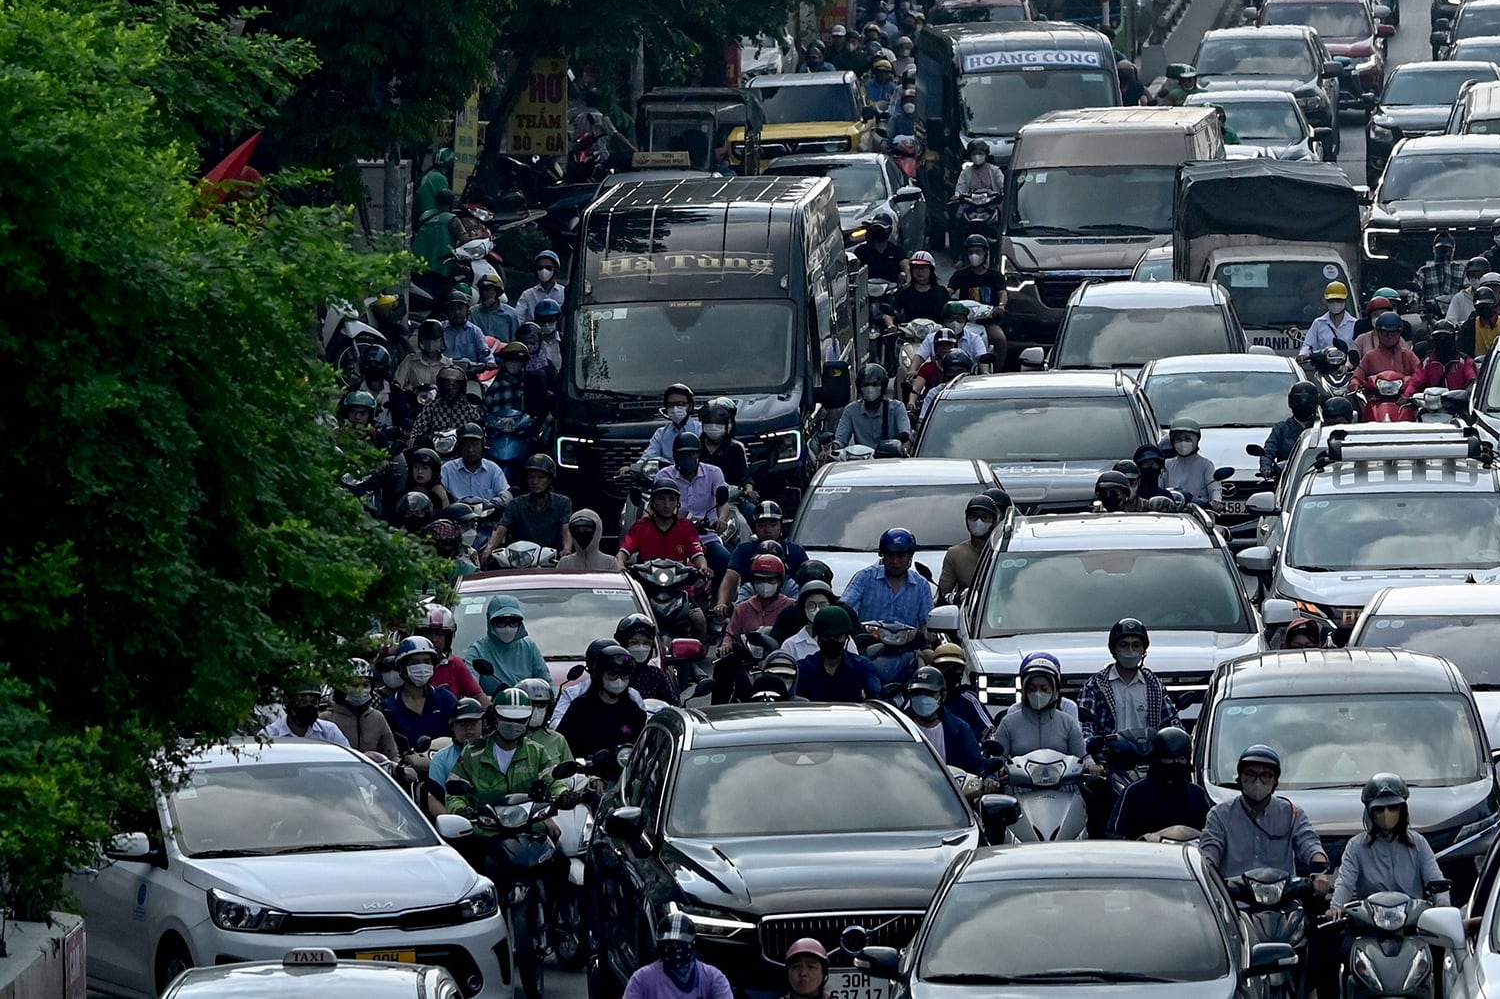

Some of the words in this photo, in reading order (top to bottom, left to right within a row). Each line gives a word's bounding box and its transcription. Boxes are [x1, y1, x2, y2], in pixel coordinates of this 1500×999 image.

[600, 255, 656, 275] Hà
[664, 254, 774, 277] Tùng
[292, 952, 324, 962] TAXI
[842, 973, 871, 988] 30H
